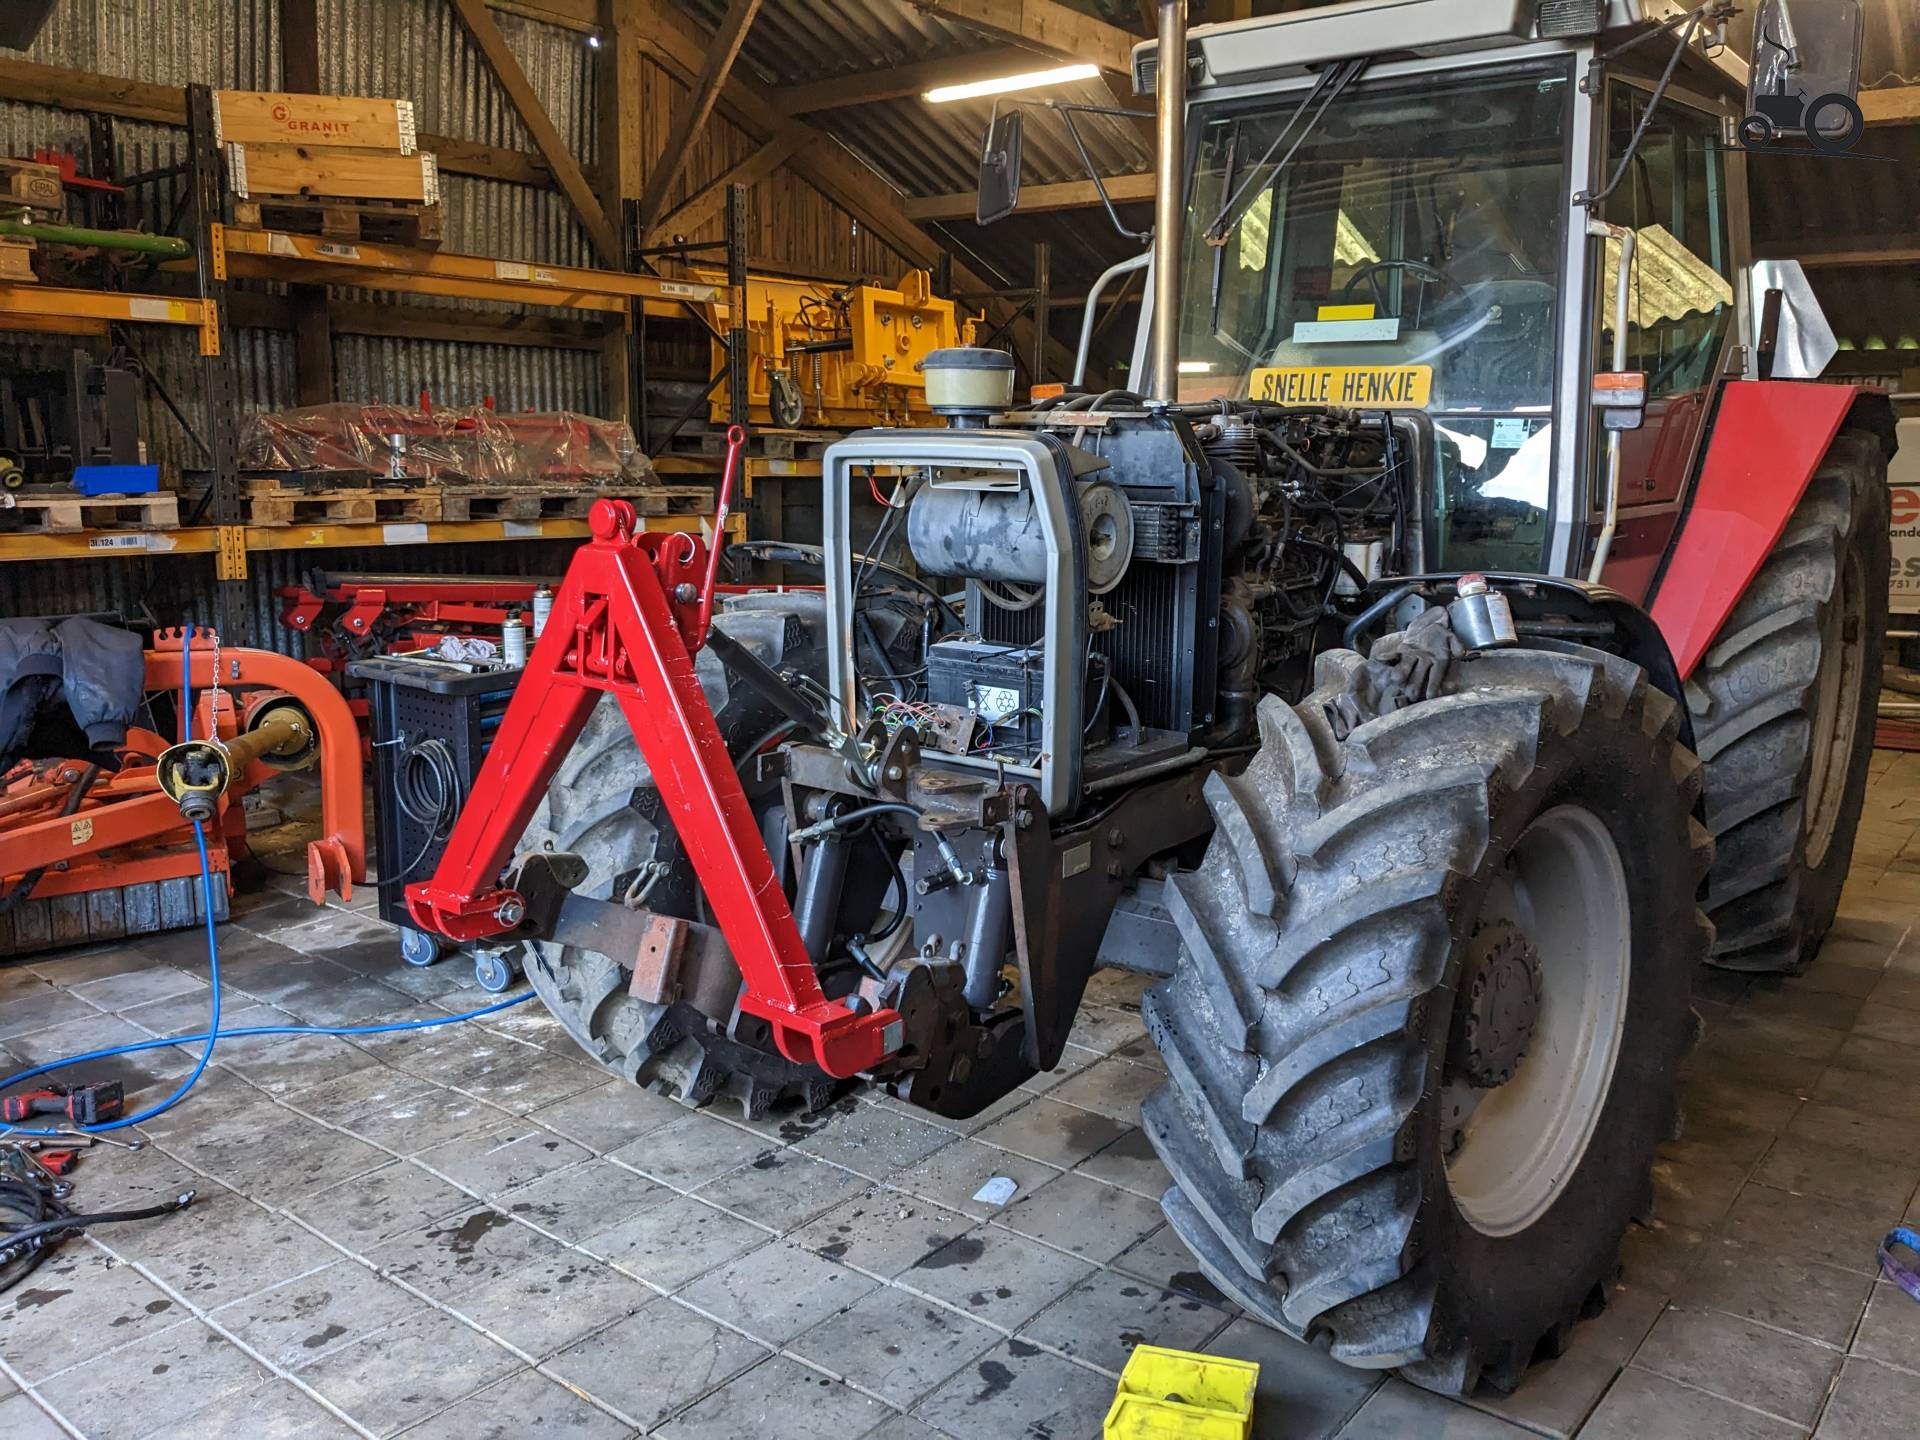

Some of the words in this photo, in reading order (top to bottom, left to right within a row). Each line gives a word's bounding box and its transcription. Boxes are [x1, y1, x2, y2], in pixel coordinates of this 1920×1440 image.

[288, 121, 350, 133] GRANIT
[1262, 373, 1331, 402] SNELLE
[1342, 371, 1417, 402] HENKIE
[1891, 488, 1920, 525] e
